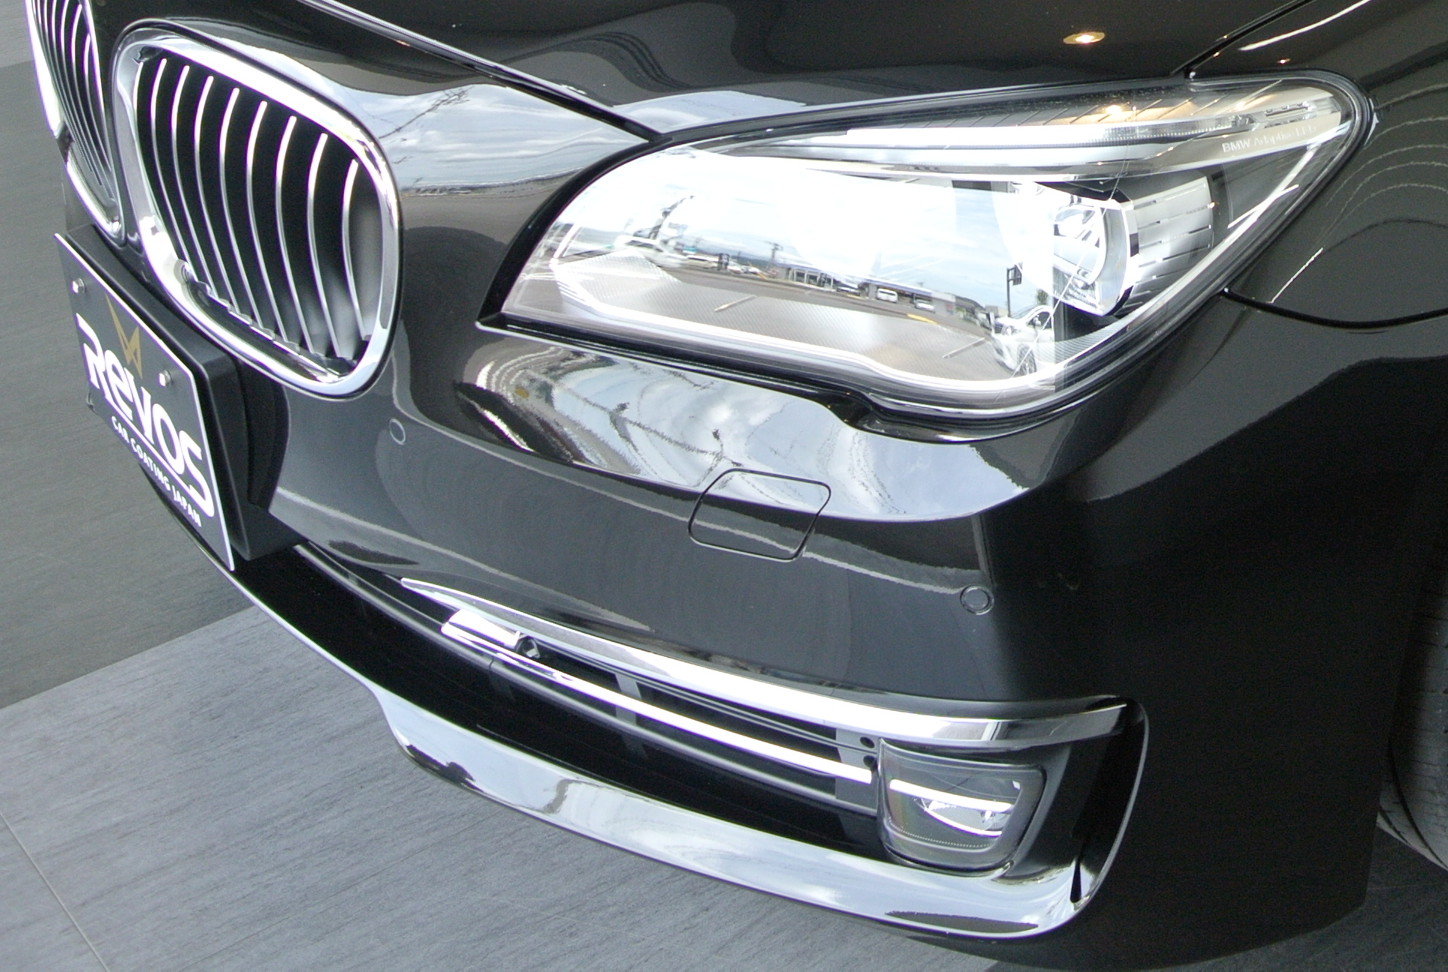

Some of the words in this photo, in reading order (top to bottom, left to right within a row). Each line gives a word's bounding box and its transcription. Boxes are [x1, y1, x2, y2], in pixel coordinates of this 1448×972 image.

[1221, 138, 1252, 153] BMW
[111, 415, 130, 444] CAR
[130, 437, 171, 492] COATING
[171, 484, 202, 528] JAPAN
